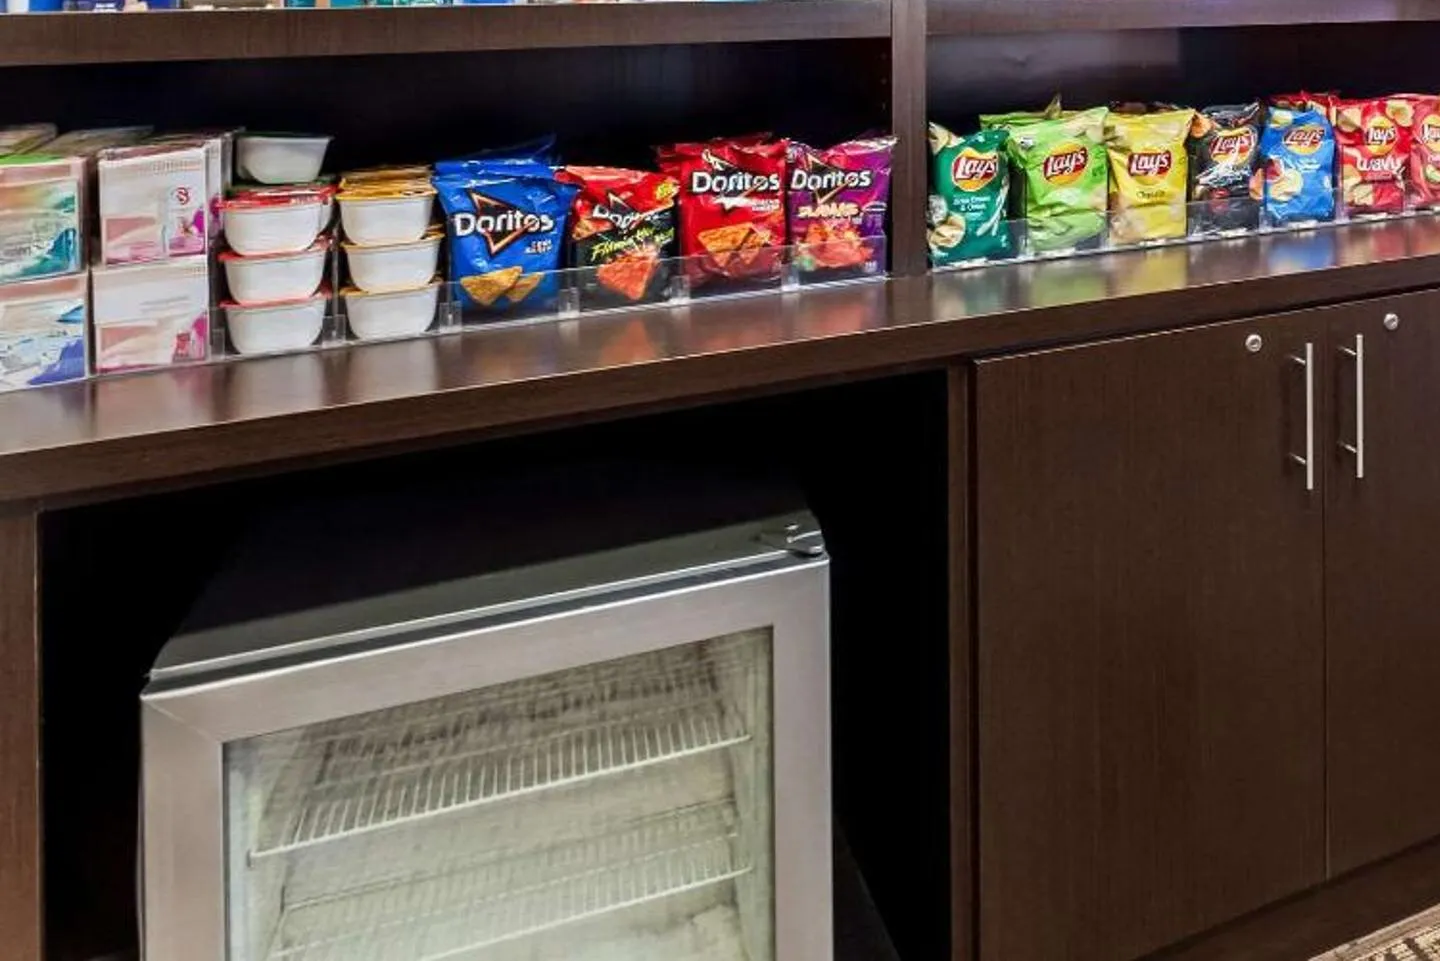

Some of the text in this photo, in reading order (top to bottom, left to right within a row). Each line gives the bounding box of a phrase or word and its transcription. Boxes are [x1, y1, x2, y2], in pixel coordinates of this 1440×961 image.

[692, 170, 780, 193] Doritos
[791, 169, 872, 190] Doritos
[454, 211, 554, 237] Doritos
